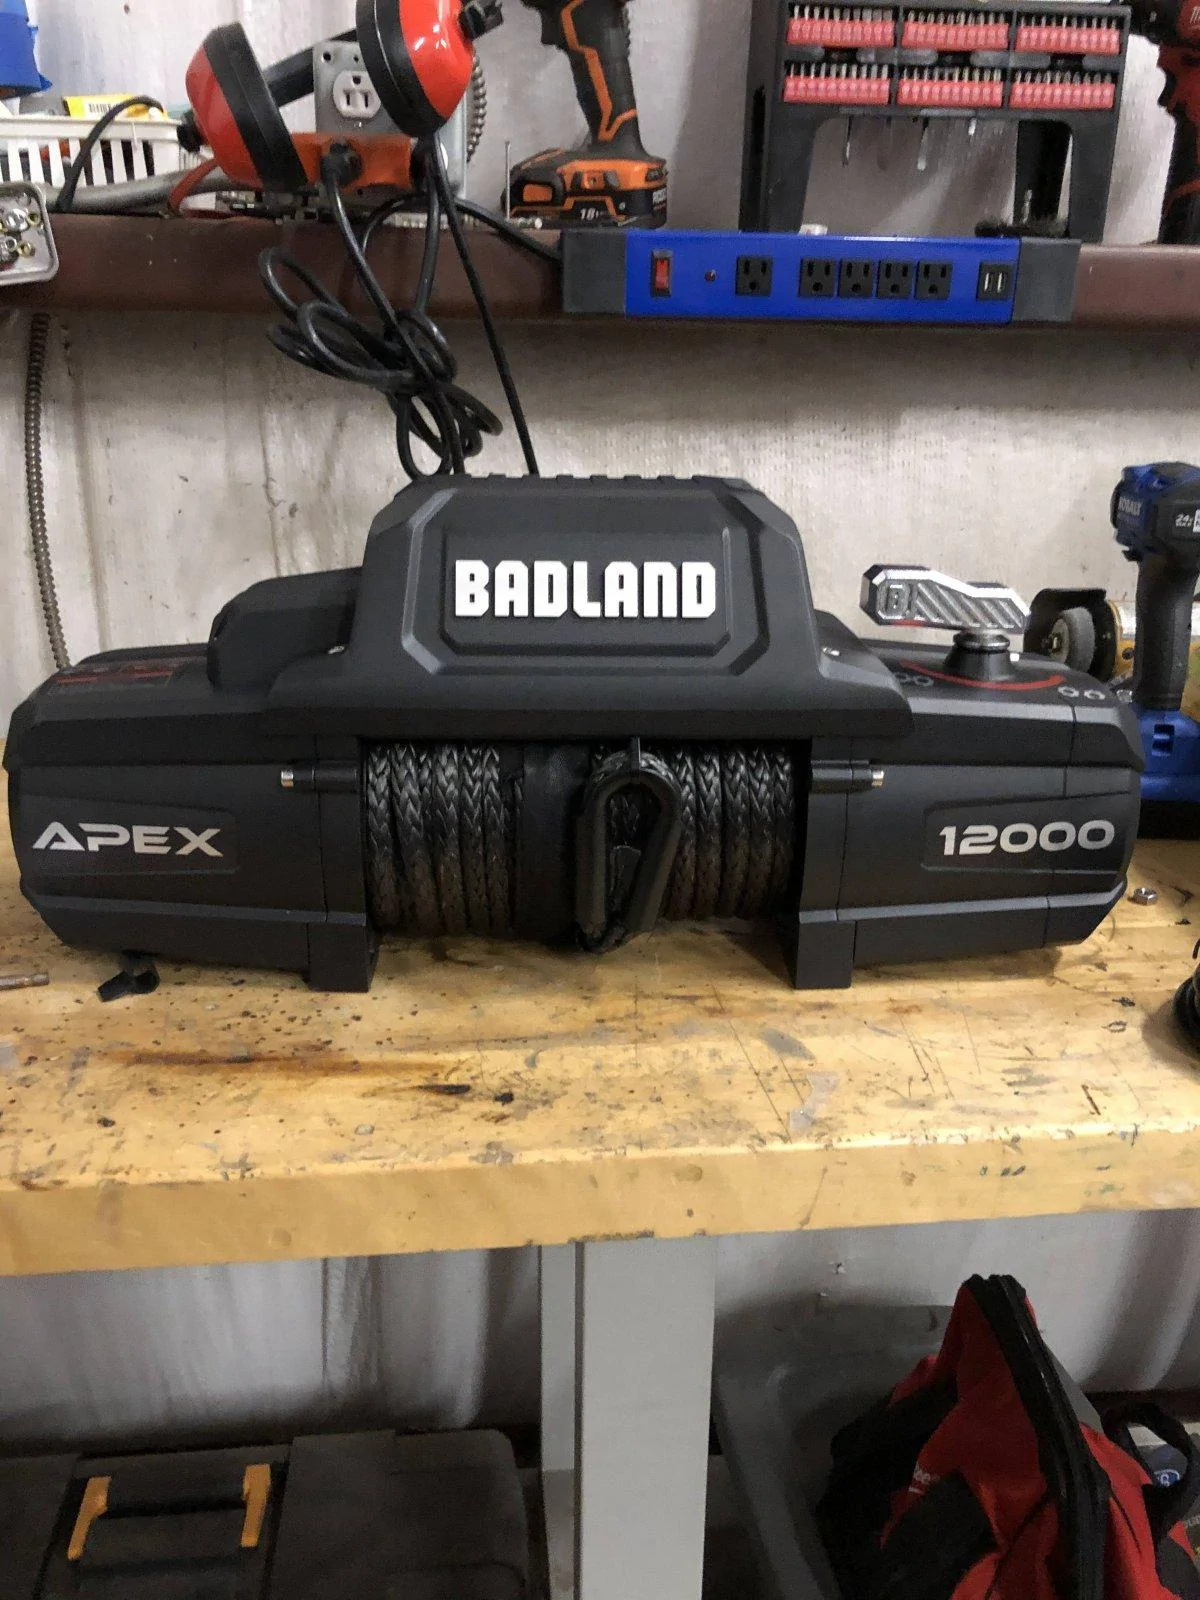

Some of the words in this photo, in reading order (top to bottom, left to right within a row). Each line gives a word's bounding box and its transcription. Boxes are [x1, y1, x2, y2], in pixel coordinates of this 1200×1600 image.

[455, 559, 716, 618] BADLAND
[32, 821, 223, 857] APEX
[939, 819, 1115, 856] 12000
